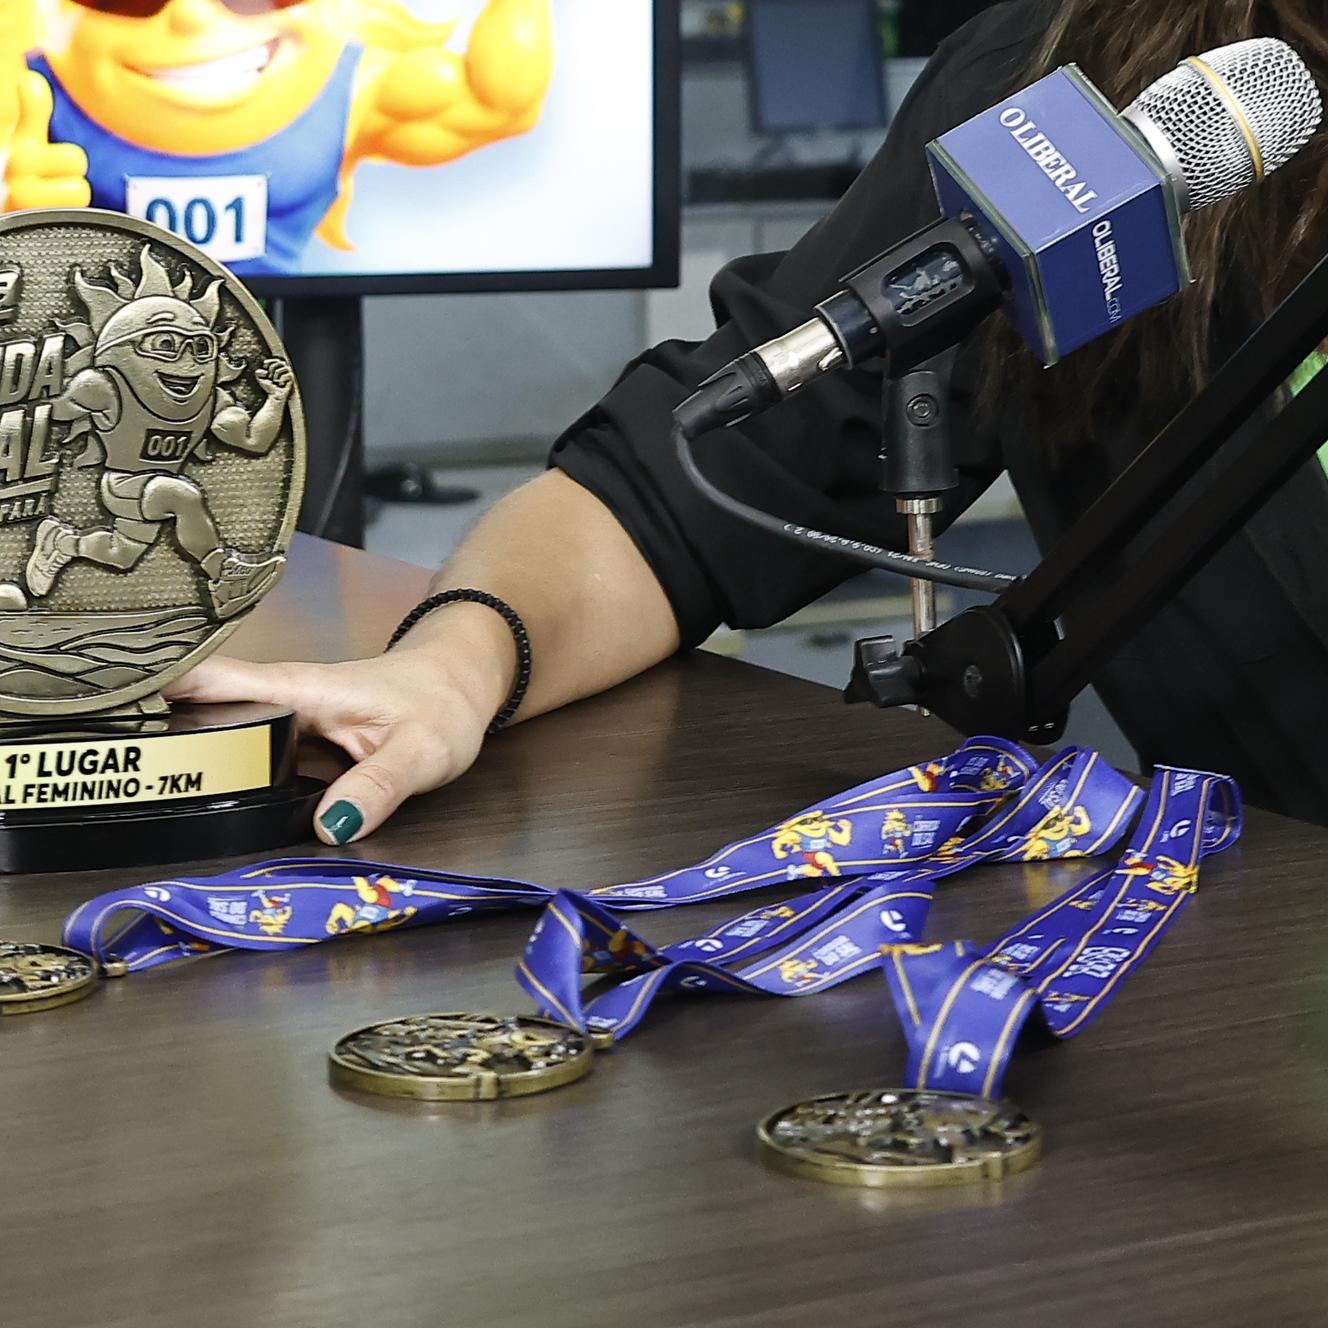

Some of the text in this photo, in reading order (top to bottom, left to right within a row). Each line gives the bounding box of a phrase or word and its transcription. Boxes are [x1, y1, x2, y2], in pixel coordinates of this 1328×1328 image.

[145, 197, 246, 244] 001
[147, 434, 188, 457] 001
[36, 745, 142, 778] LUGAR
[22, 777, 141, 804] FEMININO
[158, 771, 204, 796] 7KM
